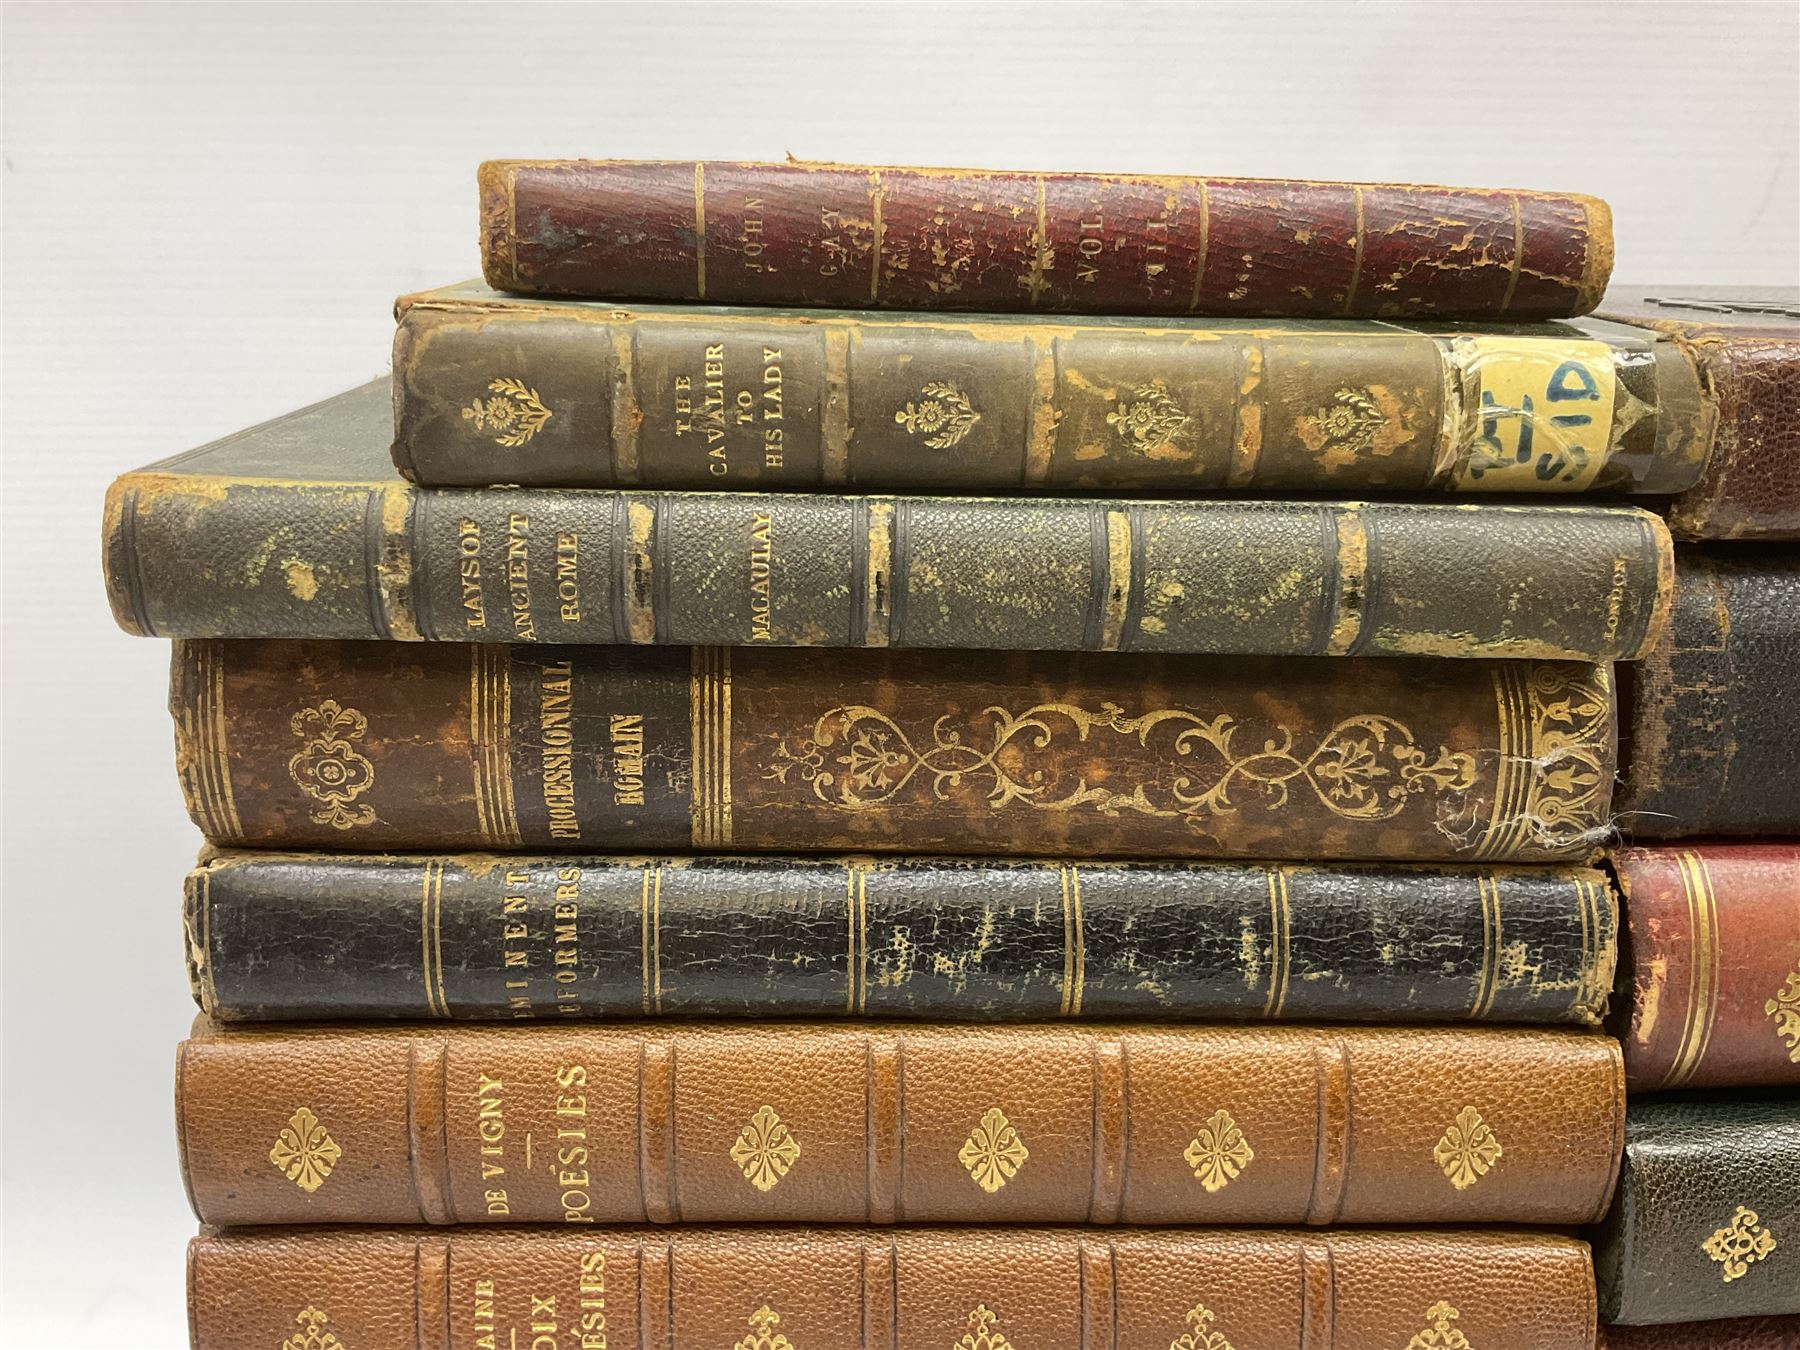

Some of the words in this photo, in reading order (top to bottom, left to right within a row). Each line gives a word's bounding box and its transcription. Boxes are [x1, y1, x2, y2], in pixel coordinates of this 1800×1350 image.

[743, 196, 764, 273] JOHN
[819, 205, 841, 276] GAY
[675, 375, 692, 437] THE
[705, 343, 728, 477] CAVALIER
[737, 390, 753, 425] TO
[763, 346, 783, 421] LADY
[766, 428, 783, 468] HIS
[459, 517, 481, 556] OF
[751, 511, 772, 641] MACAULAY
[461, 558, 487, 630] LAYS
[508, 512, 537, 641] ANCIENT
[556, 531, 581, 624] ROME
[1603, 559, 1626, 641] LONDON
[540, 661, 581, 840] PROCESSIONNAL
[610, 713, 645, 806] ROMAIN
[554, 867, 582, 1013] EFORMERS
[479, 1074, 505, 1180] VIGNY
[550, 1066, 594, 1222] POÉSIES
[484, 1189, 510, 1215] DE
[474, 1279, 495, 1350] AINE
[531, 1294, 557, 1350] OIX
[570, 1251, 607, 1350] ÉSIES
